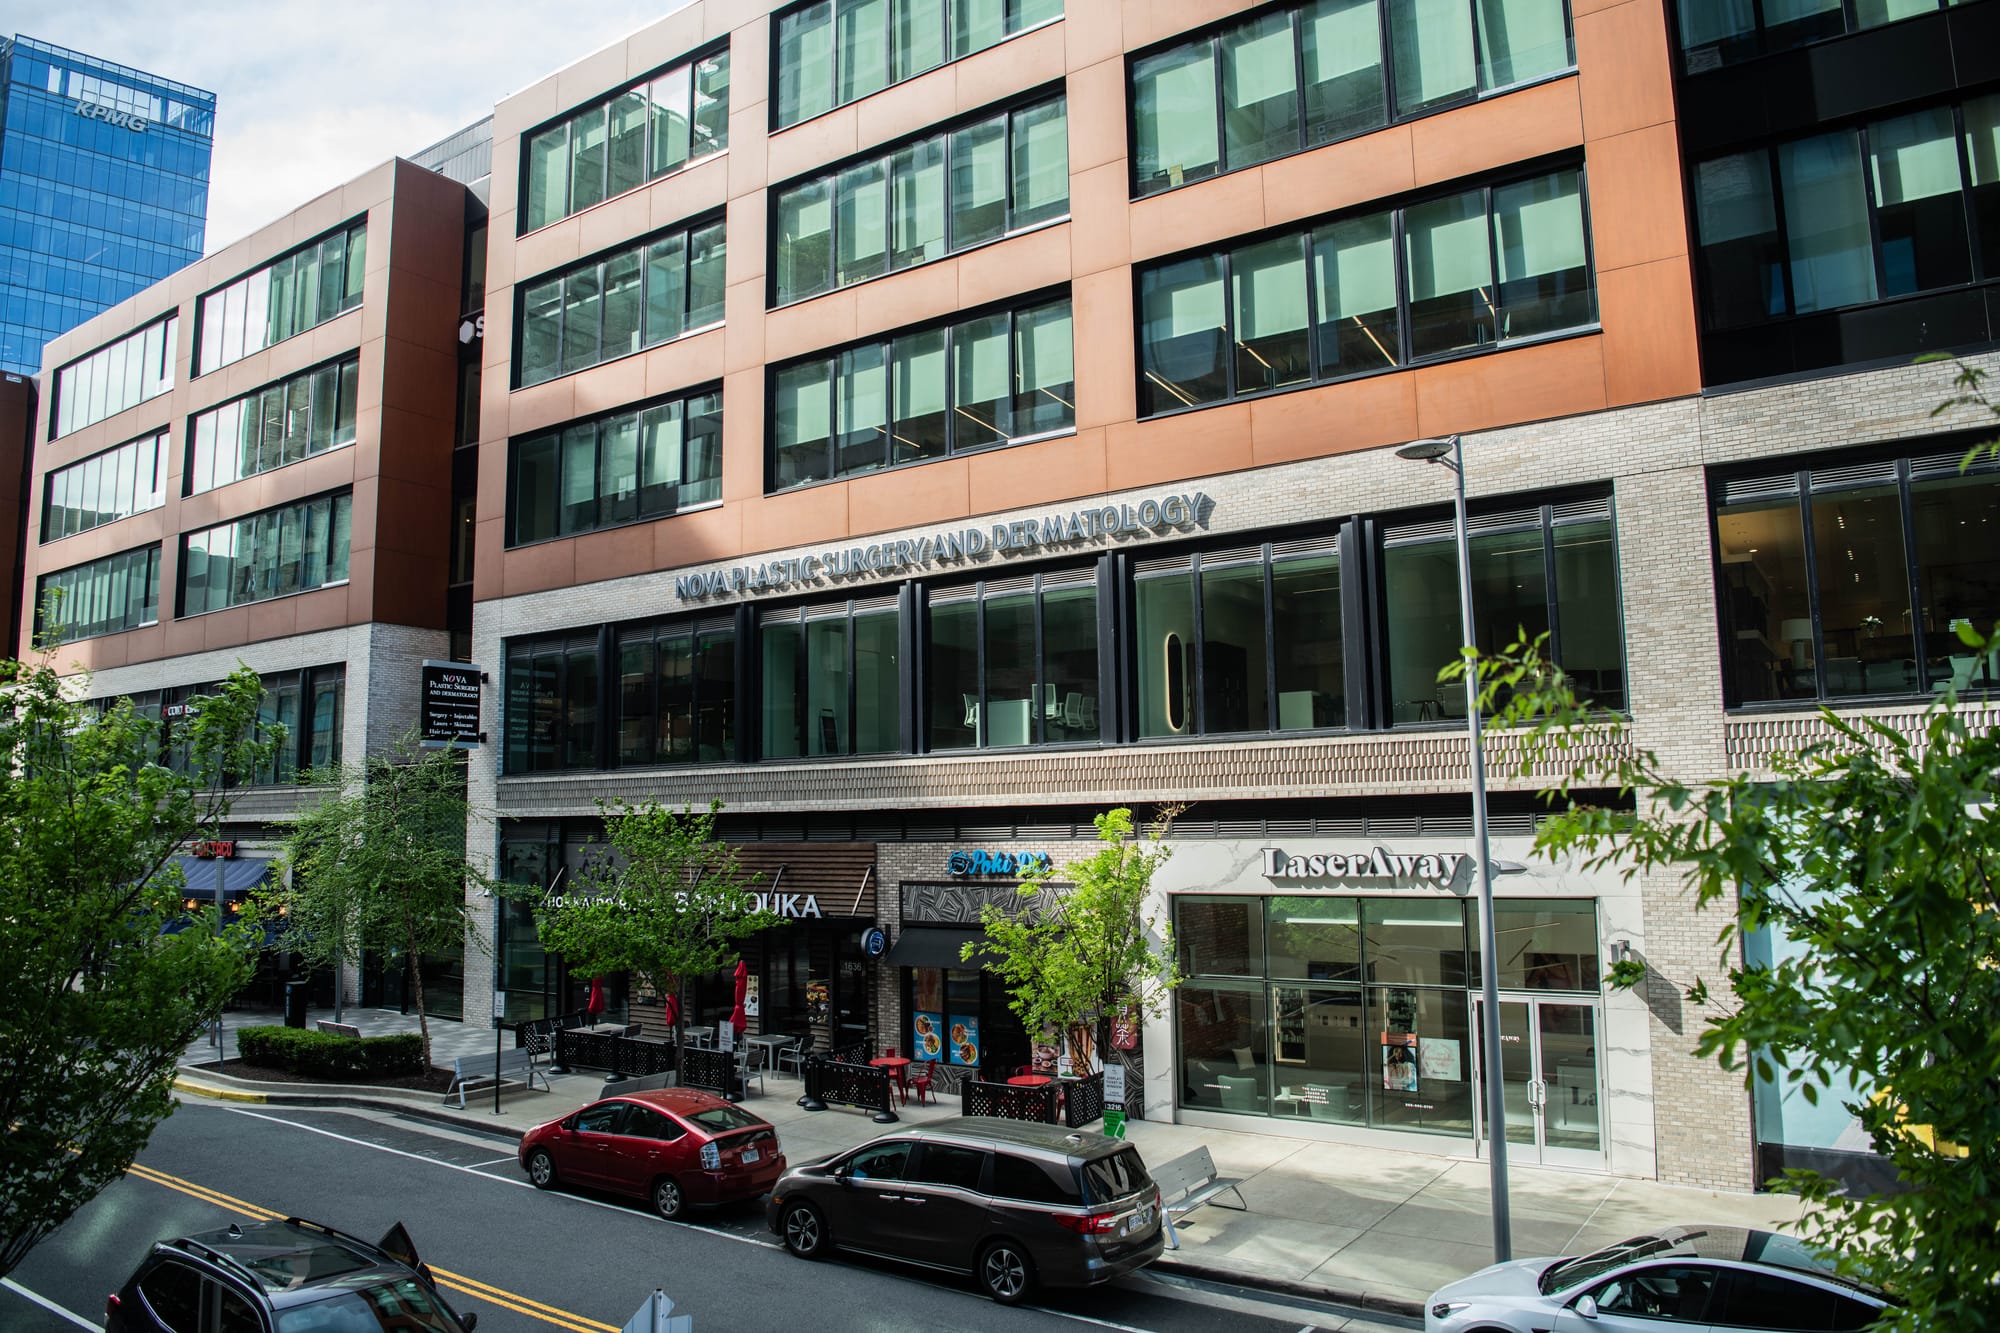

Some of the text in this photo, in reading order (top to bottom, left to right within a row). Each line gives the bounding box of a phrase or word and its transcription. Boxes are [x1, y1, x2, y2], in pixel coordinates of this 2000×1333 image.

[73, 100, 148, 132] KPMG
[675, 491, 1204, 600] NOVA PLASTIC SURGERY AND DERMATOLOGY
[442, 674, 467, 684] NOVA
[211, 841, 232, 857] TACO
[968, 849, 1014, 875] Poki
[1261, 847, 1467, 887] LaserAway
